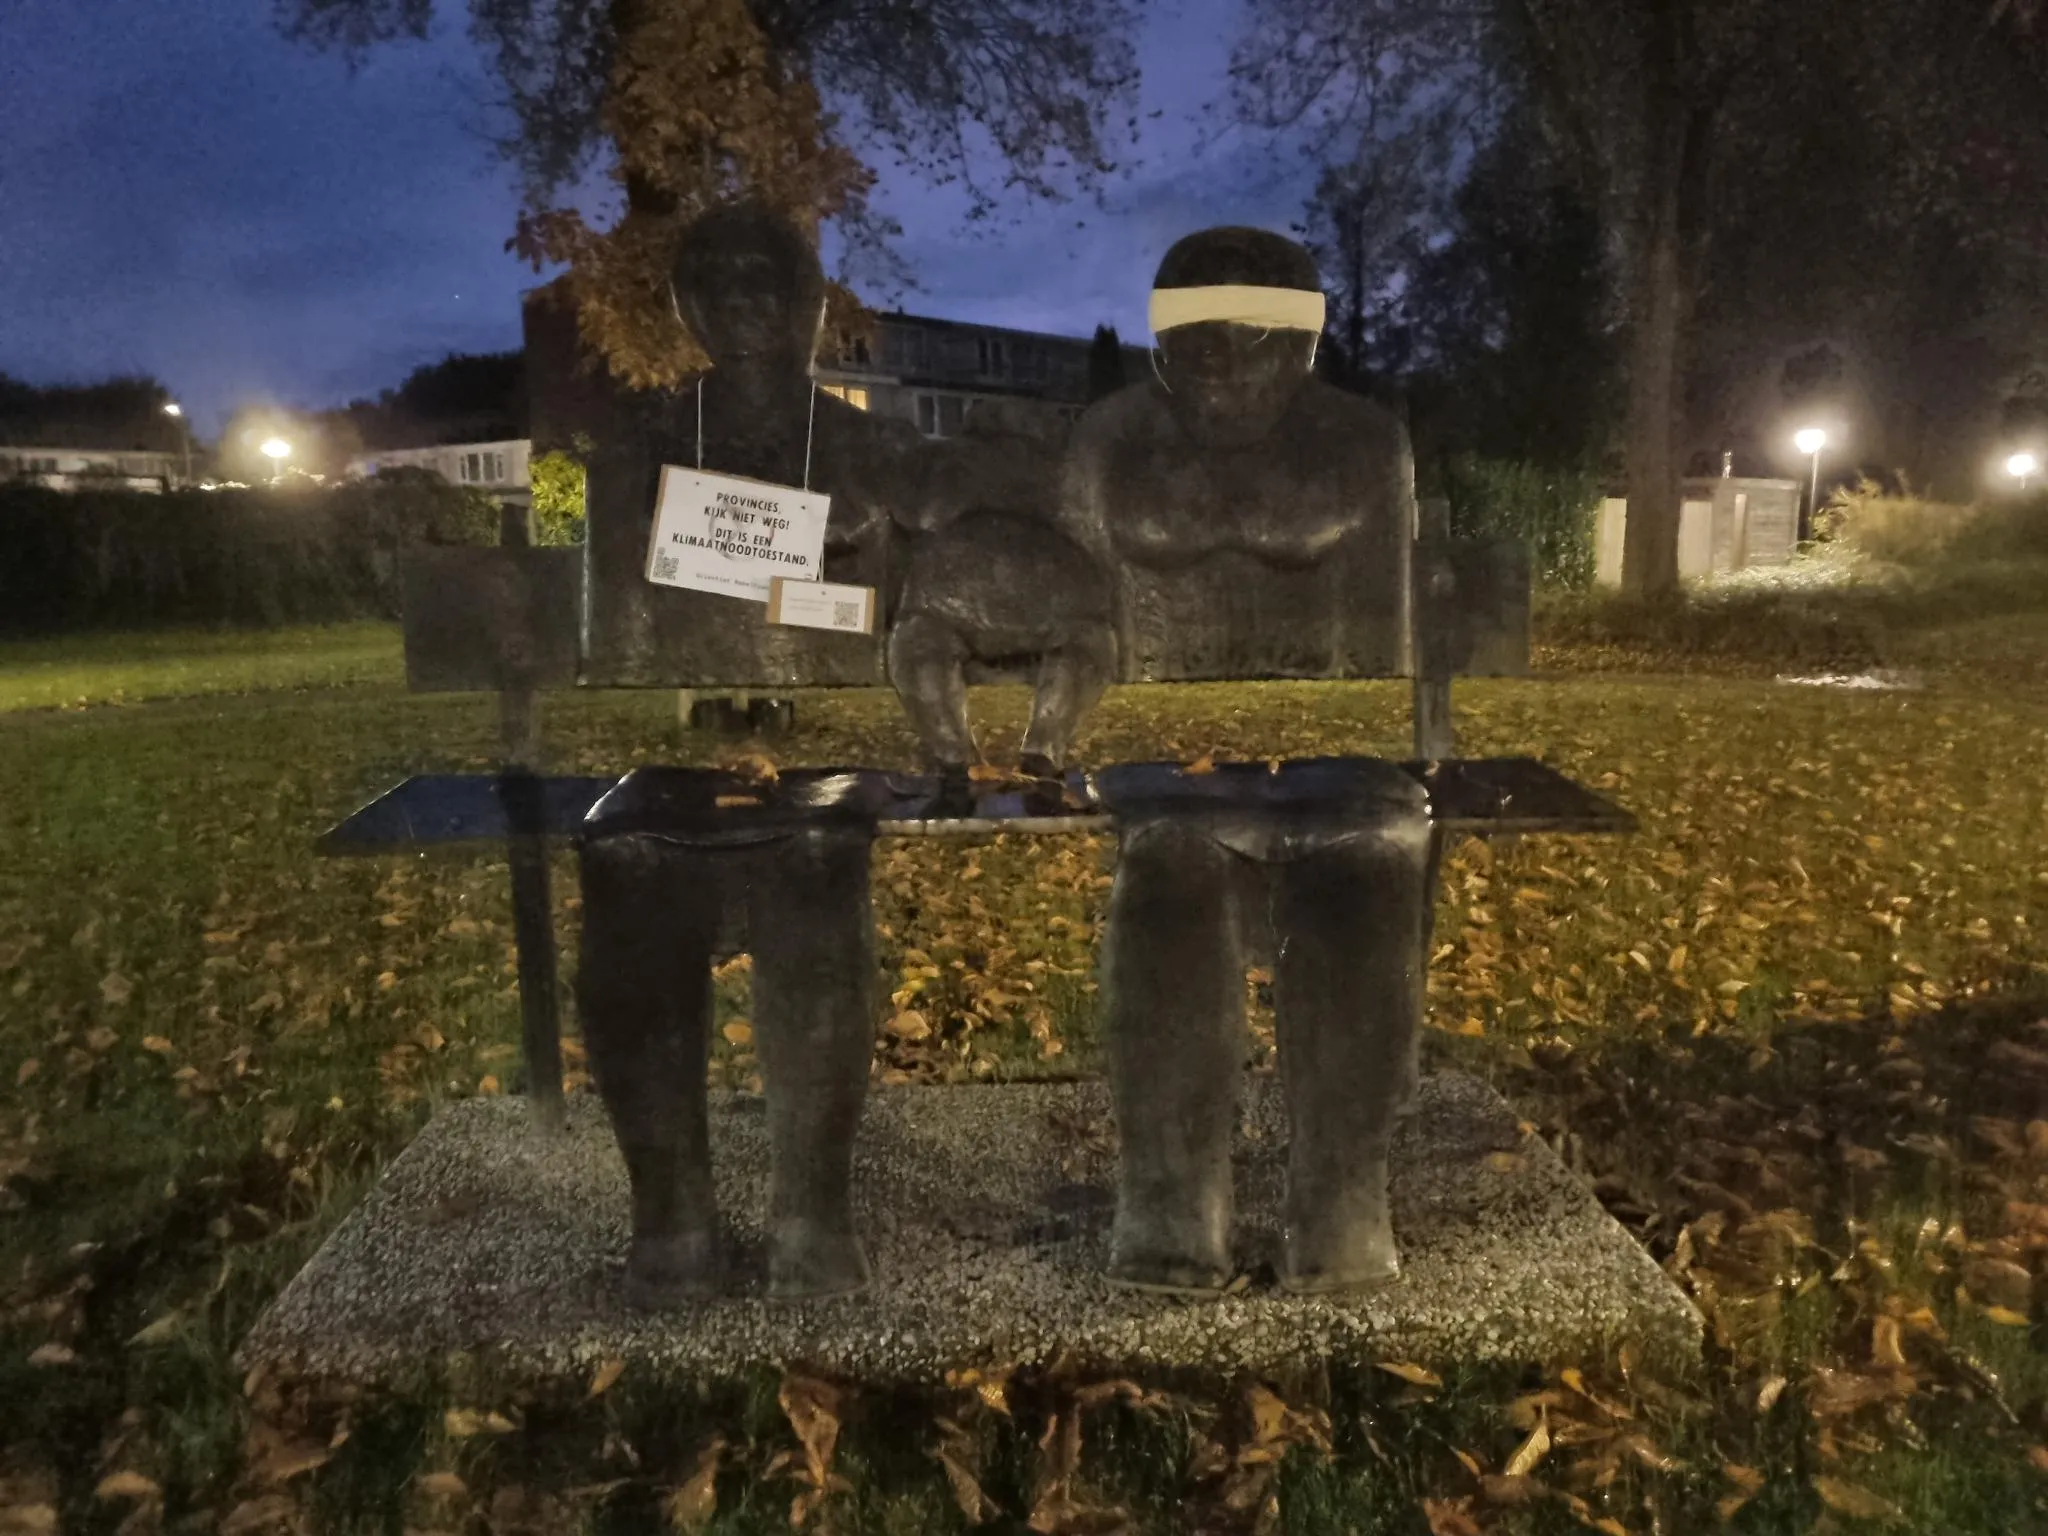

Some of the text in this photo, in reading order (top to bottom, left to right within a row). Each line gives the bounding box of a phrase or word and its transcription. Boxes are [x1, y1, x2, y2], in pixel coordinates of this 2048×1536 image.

[704, 506, 790, 530] KIJK NIET WEG!
[716, 528, 772, 547] DIT IS EEN
